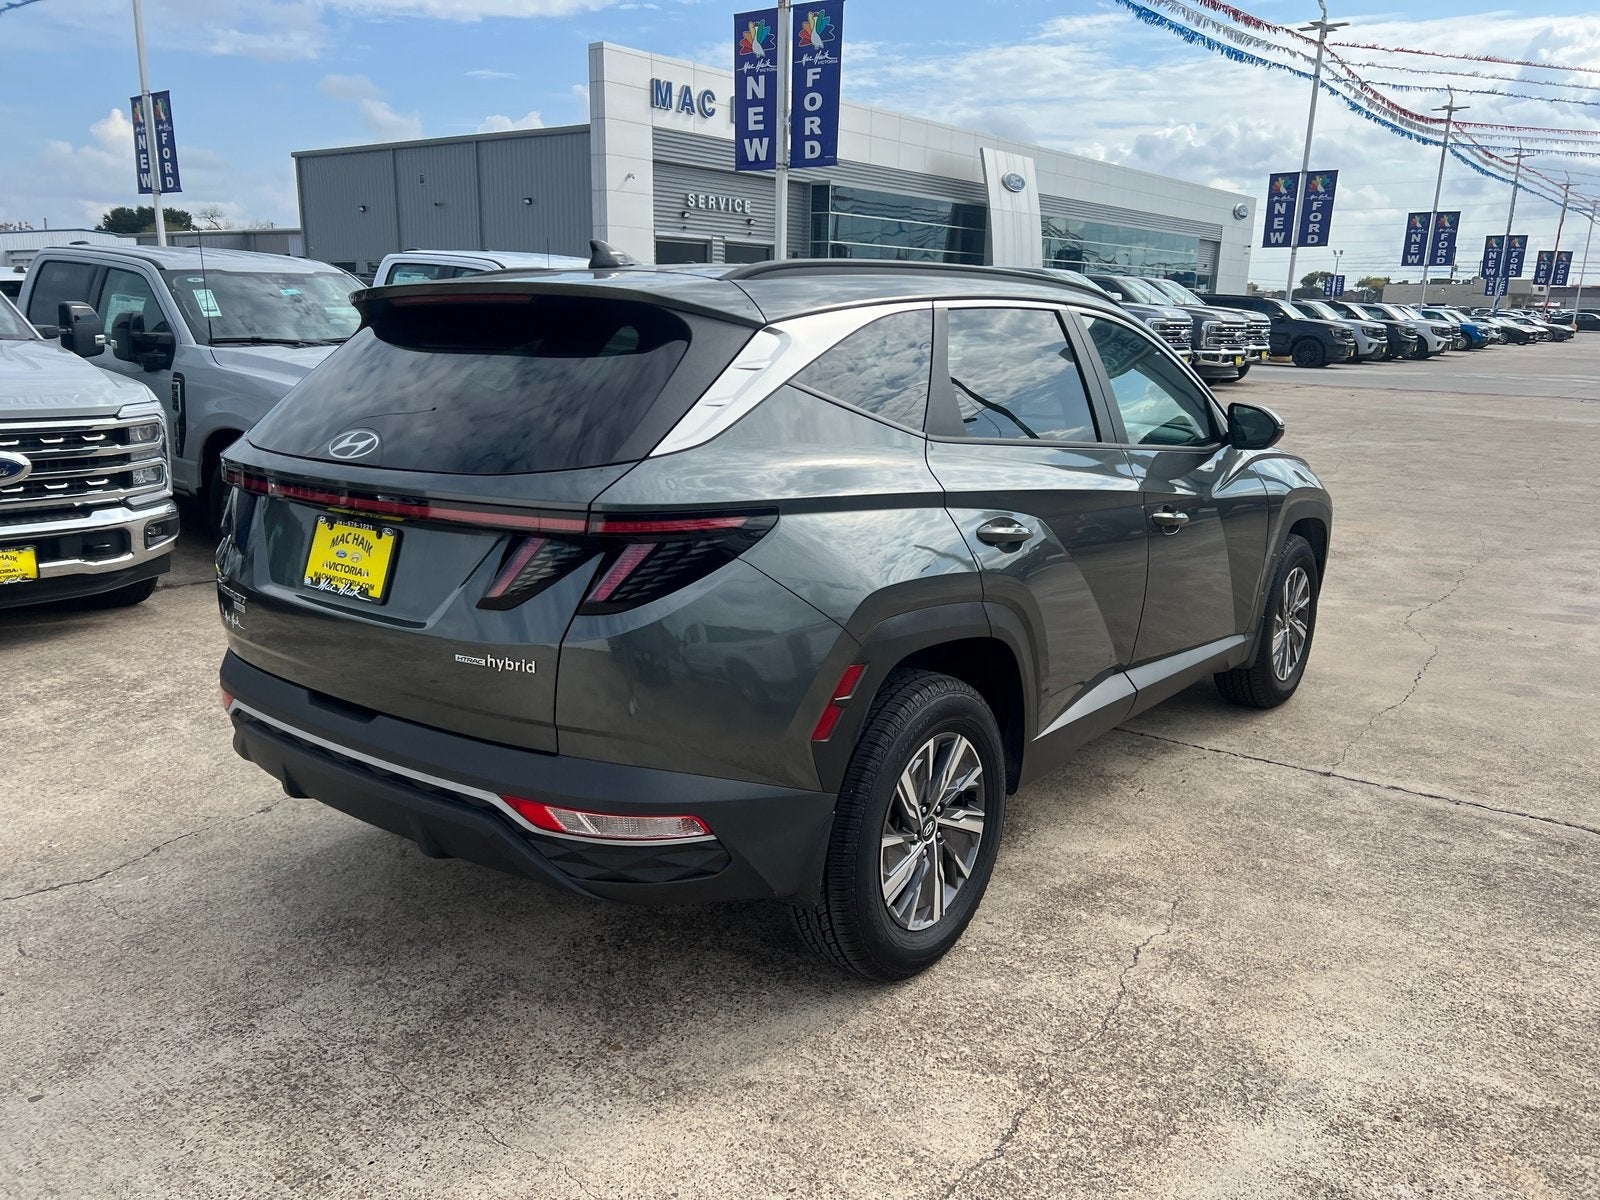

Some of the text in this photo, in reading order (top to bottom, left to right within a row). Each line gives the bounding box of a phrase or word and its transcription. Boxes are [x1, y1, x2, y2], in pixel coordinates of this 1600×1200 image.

[650, 77, 717, 119] MAC
[743, 75, 769, 162] NEW
[803, 68, 823, 160] FORD
[138, 134, 152, 188] NEW
[162, 133, 174, 188] FORD
[687, 192, 752, 214] SERVICE
[1269, 202, 1287, 244] NEW
[1307, 201, 1322, 244] FORD
[1407, 233, 1421, 264] NEW
[1436, 233, 1449, 264] FORD
[1485, 251, 1497, 276] NEW
[1508, 251, 1519, 276] FORD
[1537, 264, 1547, 284] NEW
[1556, 265, 1565, 284] FORD
[329, 532, 373, 558] MAC HAIK
[327, 561, 363, 577] VICTORIA
[309, 578, 372, 602] Mac Haik
[456, 654, 536, 674] HTRAC hybrid
